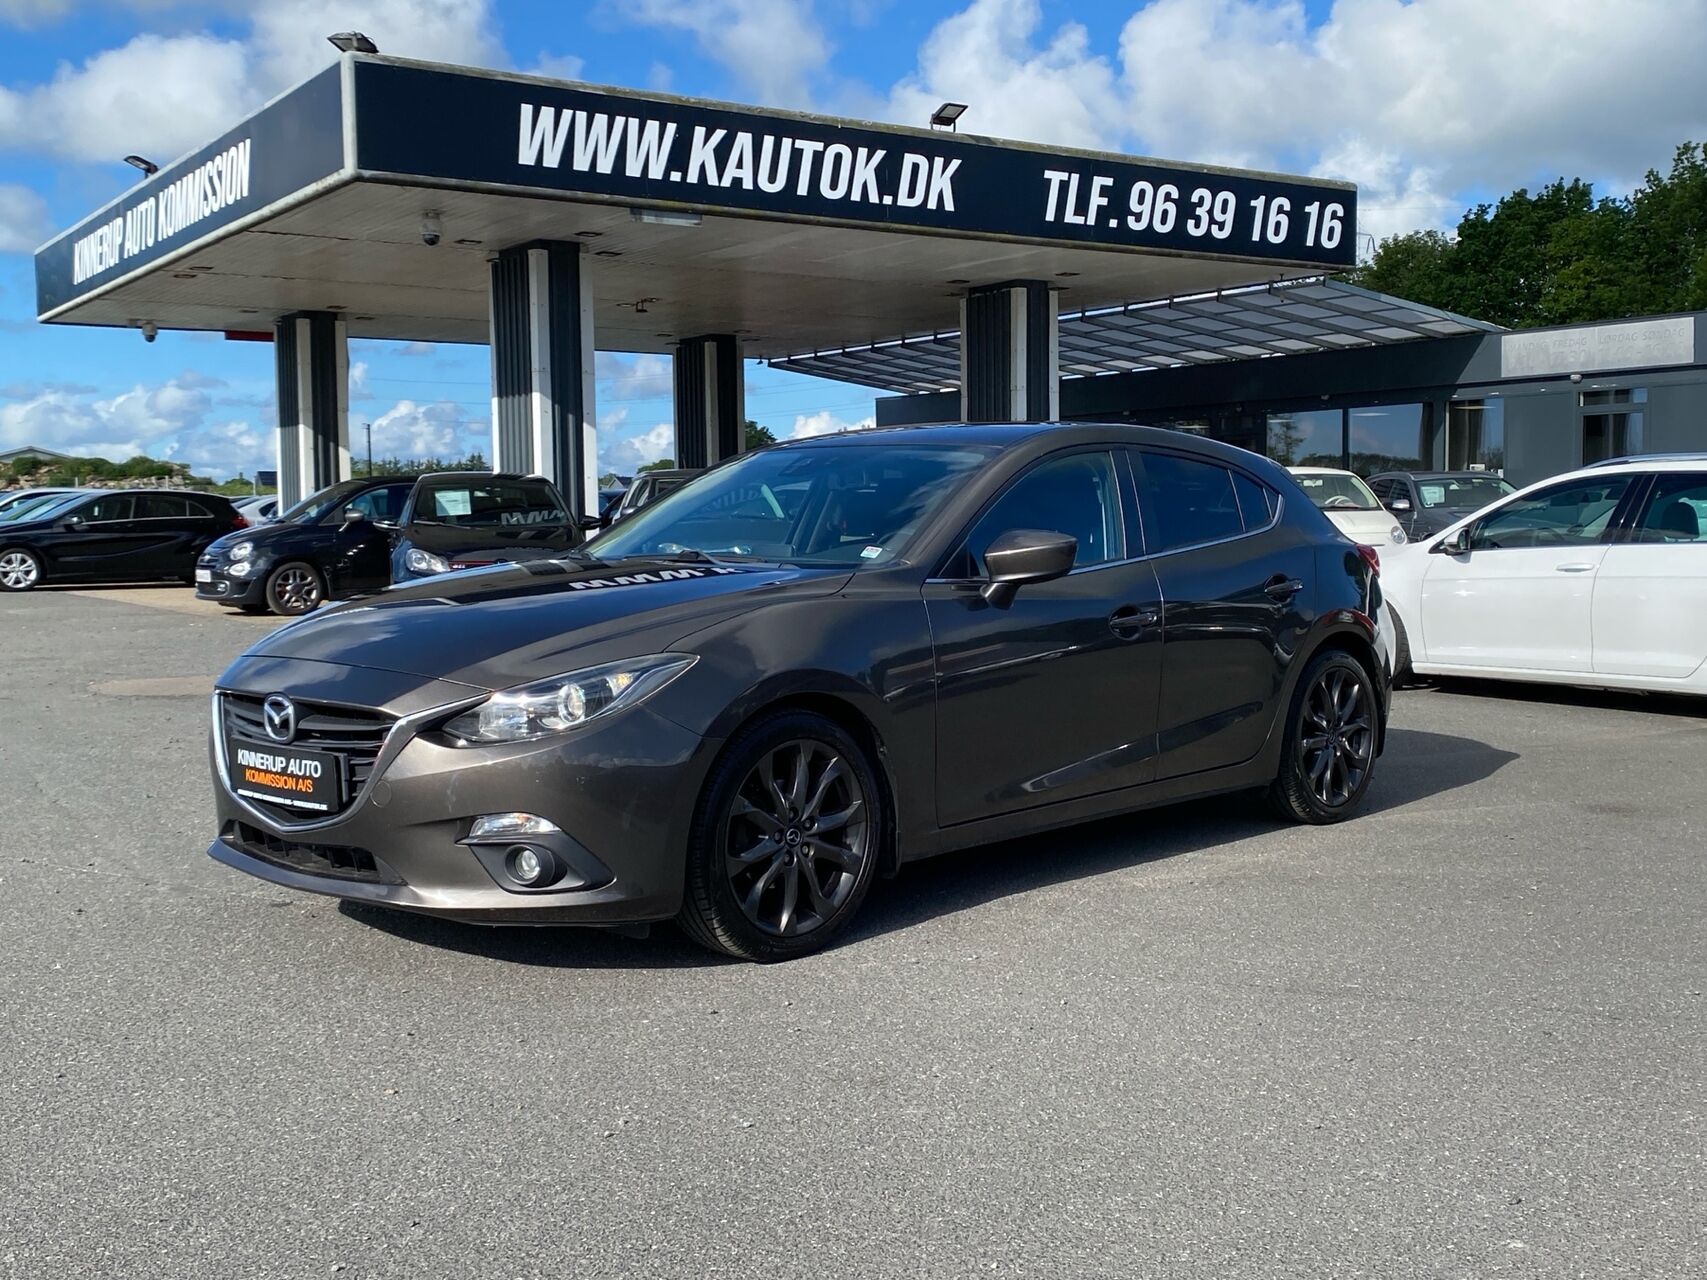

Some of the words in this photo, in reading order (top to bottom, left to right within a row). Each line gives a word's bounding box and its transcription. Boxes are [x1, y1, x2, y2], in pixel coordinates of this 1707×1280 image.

[518, 103, 961, 212] WWW.KAUTOK.DK
[73, 216, 124, 285] KINNERUP
[124, 197, 156, 259] AUTO
[157, 138, 251, 242] KOMMISSION
[1043, 170, 1118, 228] TLF.
[1127, 181, 1179, 233] 96
[1187, 188, 1236, 239] 39
[1250, 195, 1291, 243] 16
[1304, 201, 1345, 249] 16
[237, 748, 286, 773] KINNERUP
[287, 758, 321, 778] AUTO
[245, 768, 296, 790] KOMMISSION
[297, 779, 313, 793] A/S
